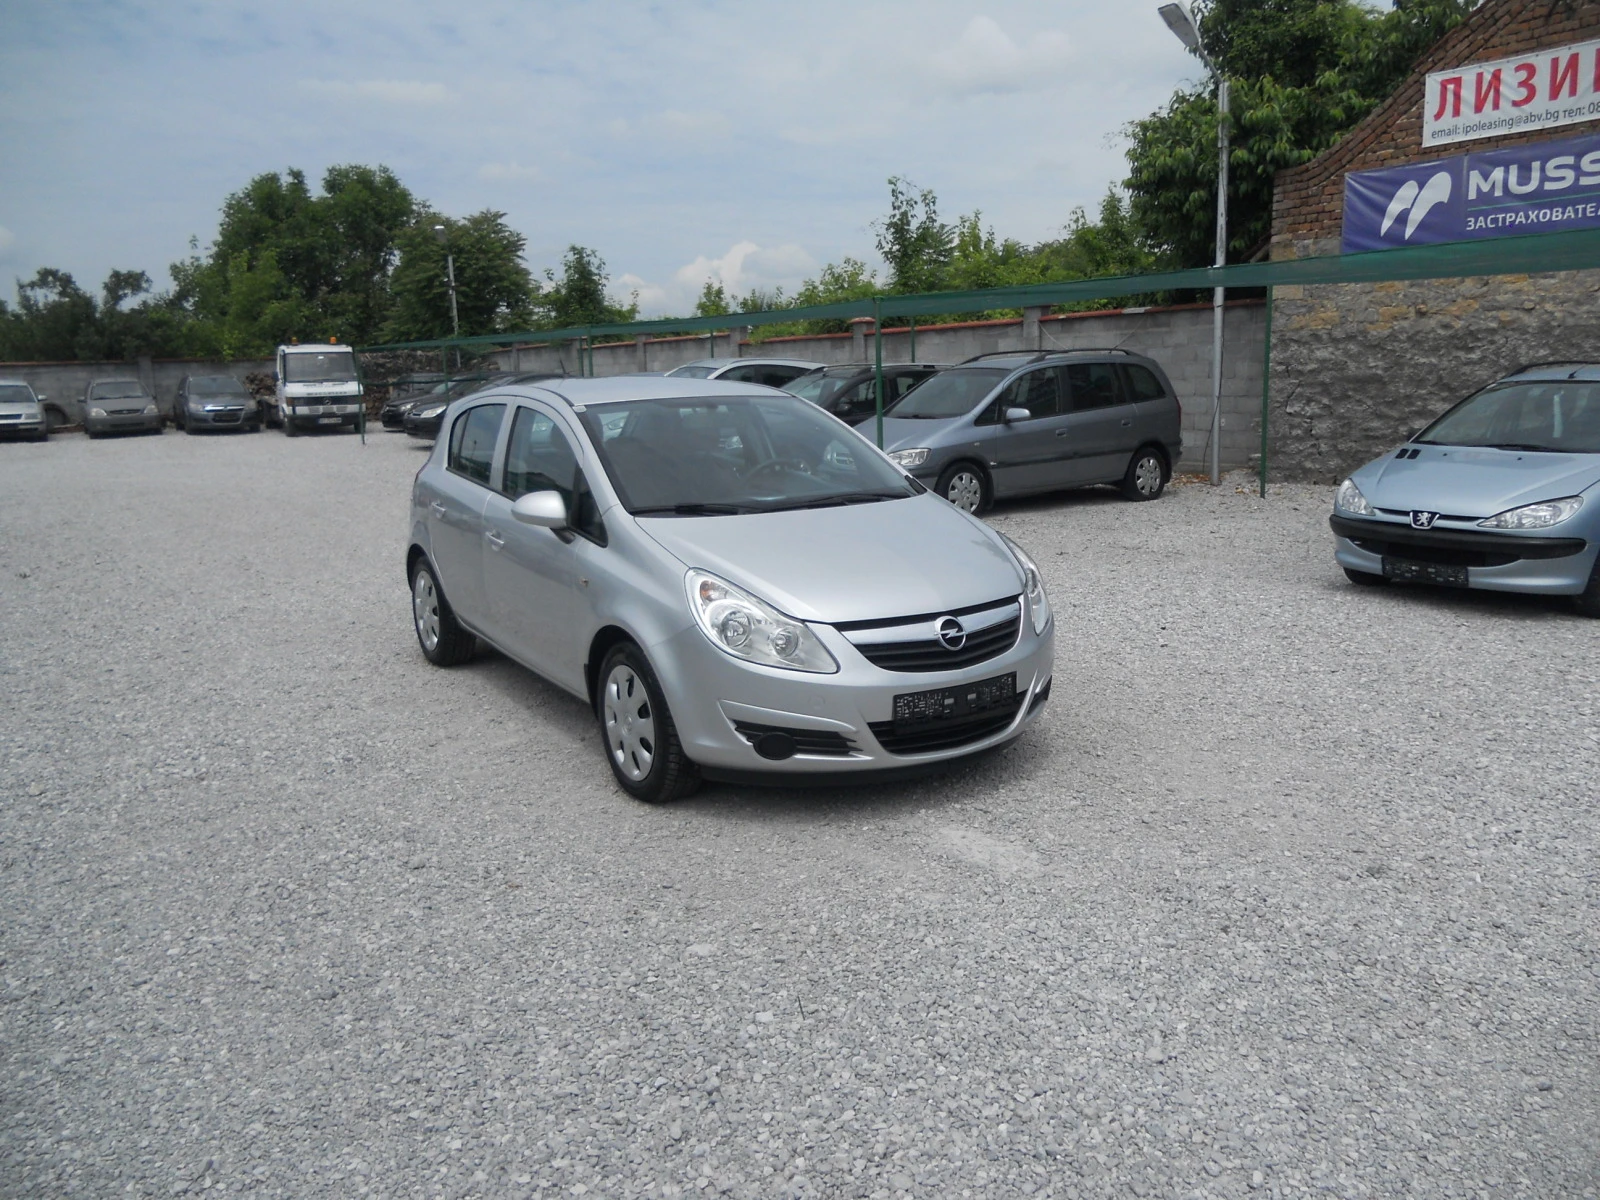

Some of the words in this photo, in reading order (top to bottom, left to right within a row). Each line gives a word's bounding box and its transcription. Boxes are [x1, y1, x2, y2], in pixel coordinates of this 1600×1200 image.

[1431, 124, 1460, 138] email:
[1462, 109, 1559, 136] ipoleasing@abv.bg
[1563, 106, 1585, 118] тел:
[1468, 150, 1600, 200] MUSS
[1466, 203, 1600, 230] ЗАСТРАХОВАТЕ
